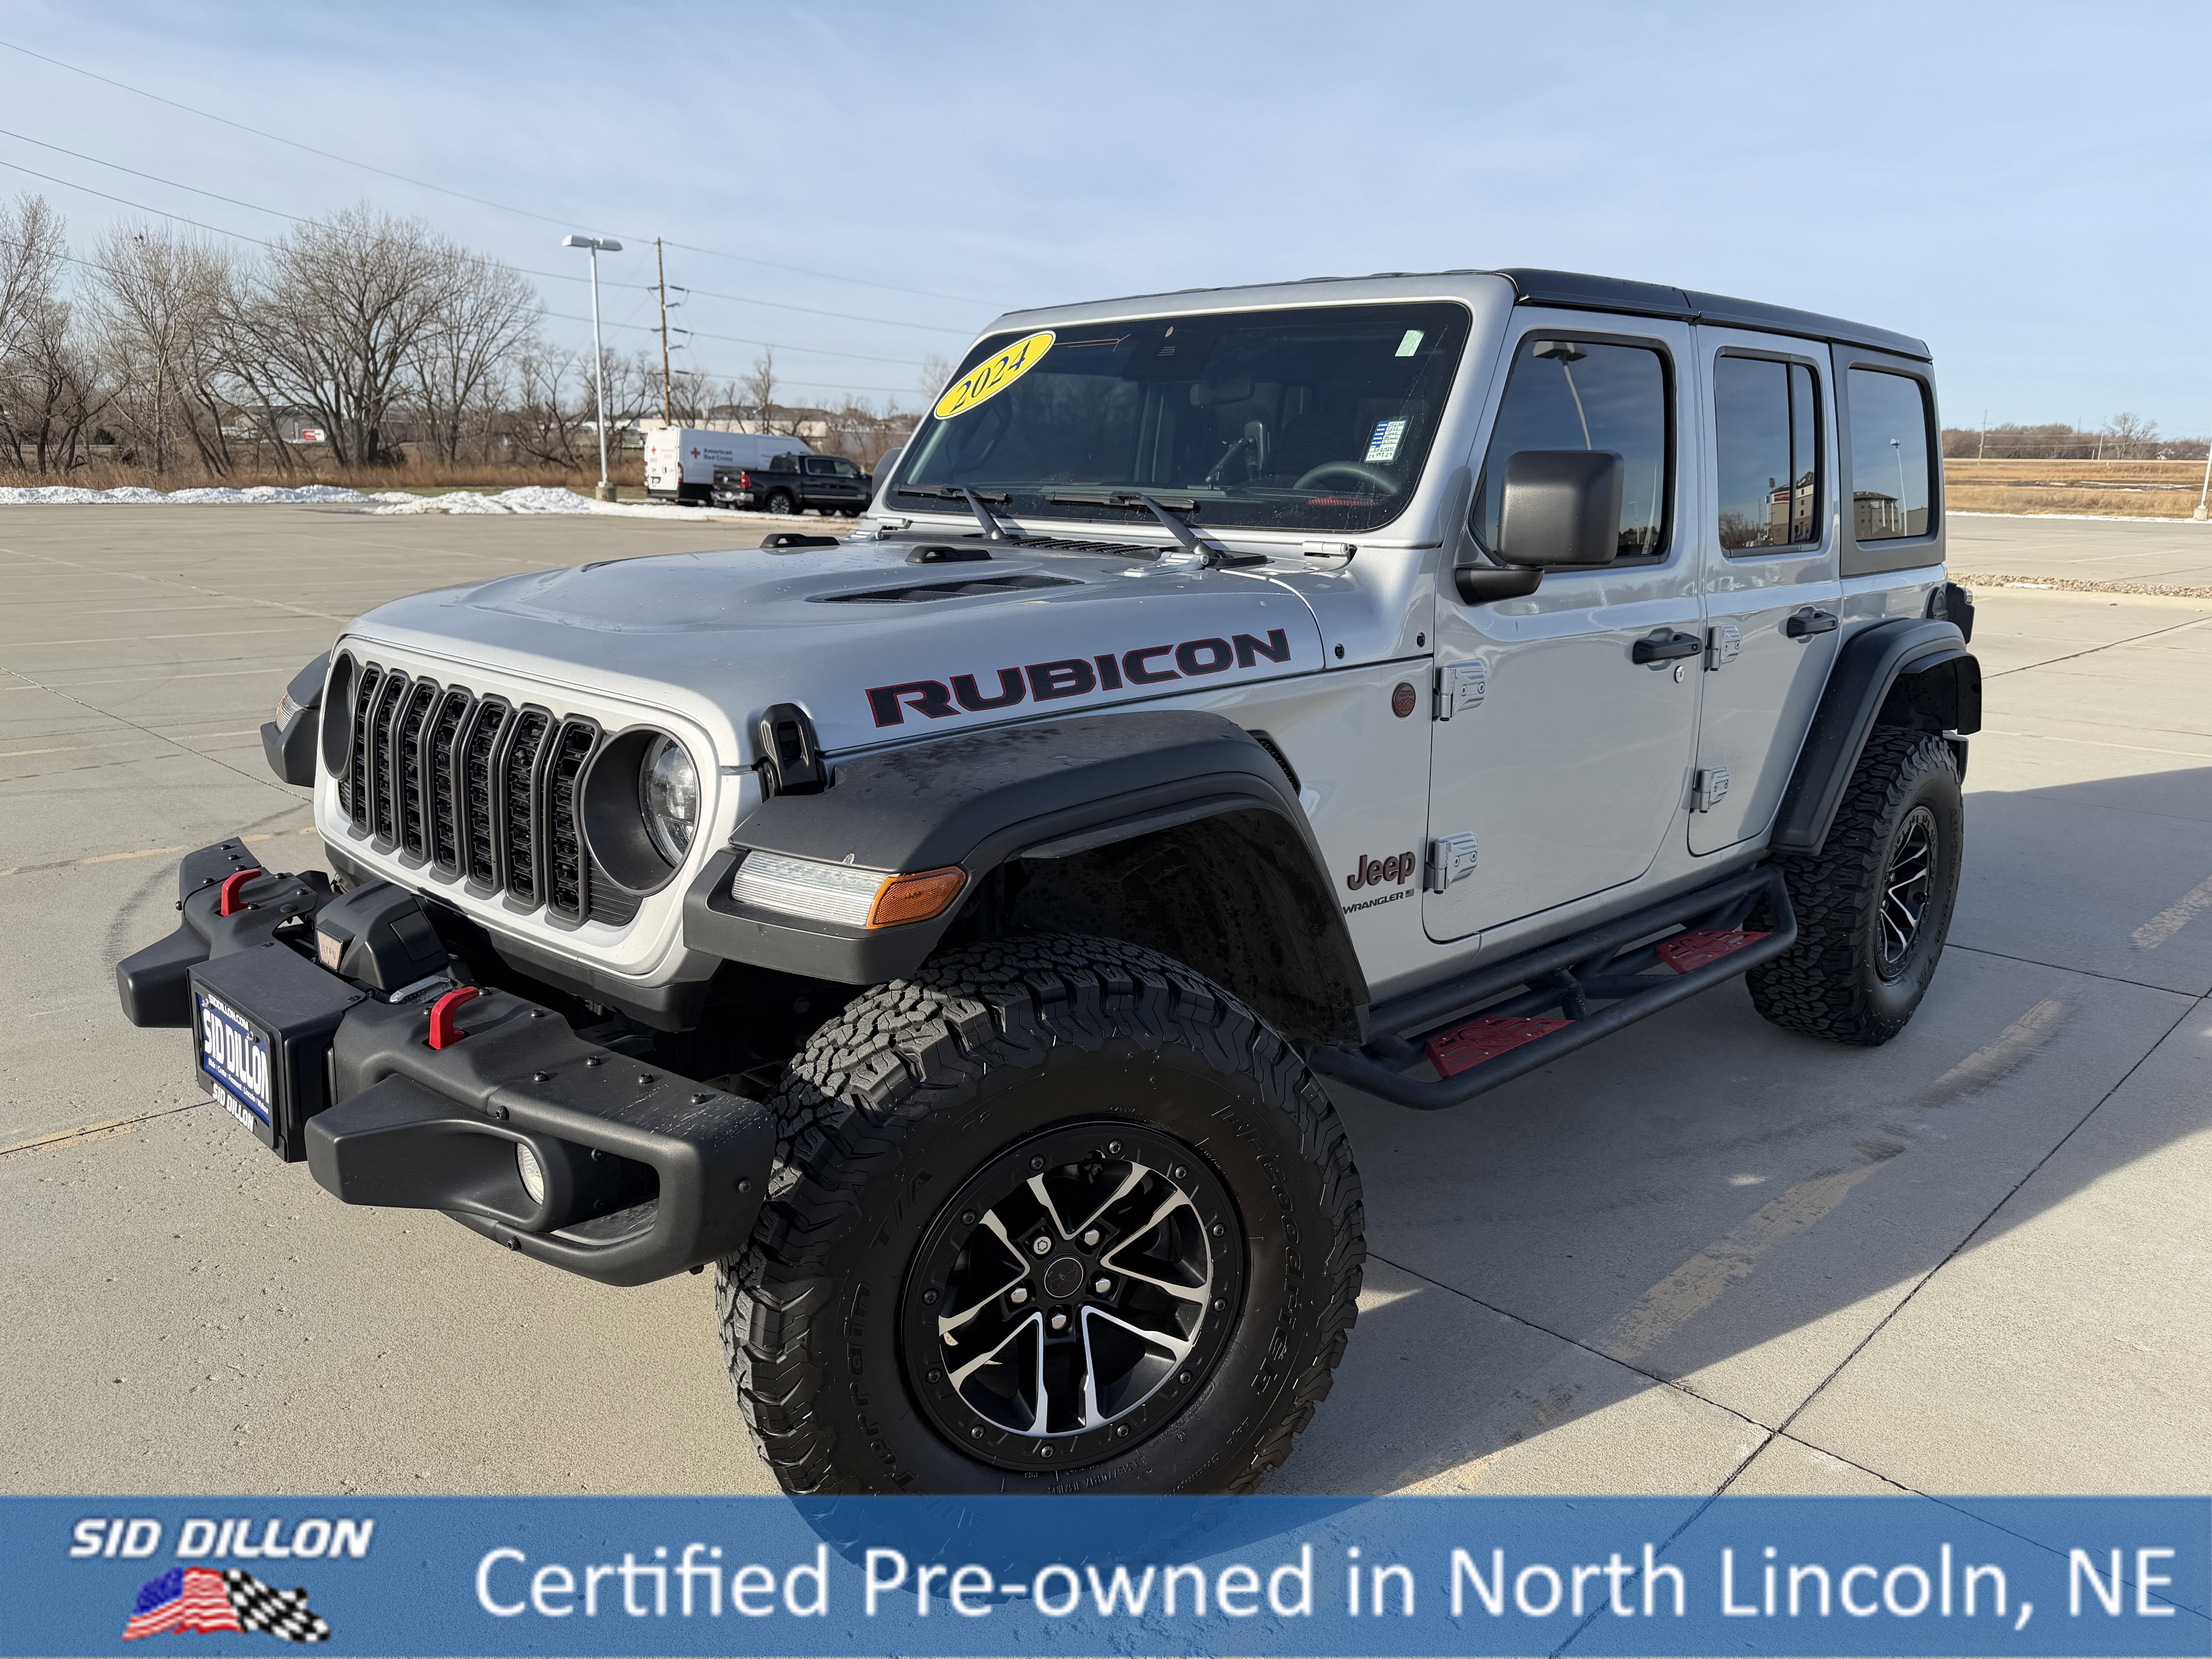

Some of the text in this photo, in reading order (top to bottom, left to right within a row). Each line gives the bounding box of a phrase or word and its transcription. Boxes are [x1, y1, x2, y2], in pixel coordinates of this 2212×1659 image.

[949, 340, 1031, 414] 2024
[865, 628, 1291, 728] RUBICON
[1347, 851, 1416, 891] Jeep
[1342, 891, 1404, 914] WRANGLER
[203, 1008, 269, 1104] SID DILLON
[212, 1082, 254, 1132] SID DILLON
